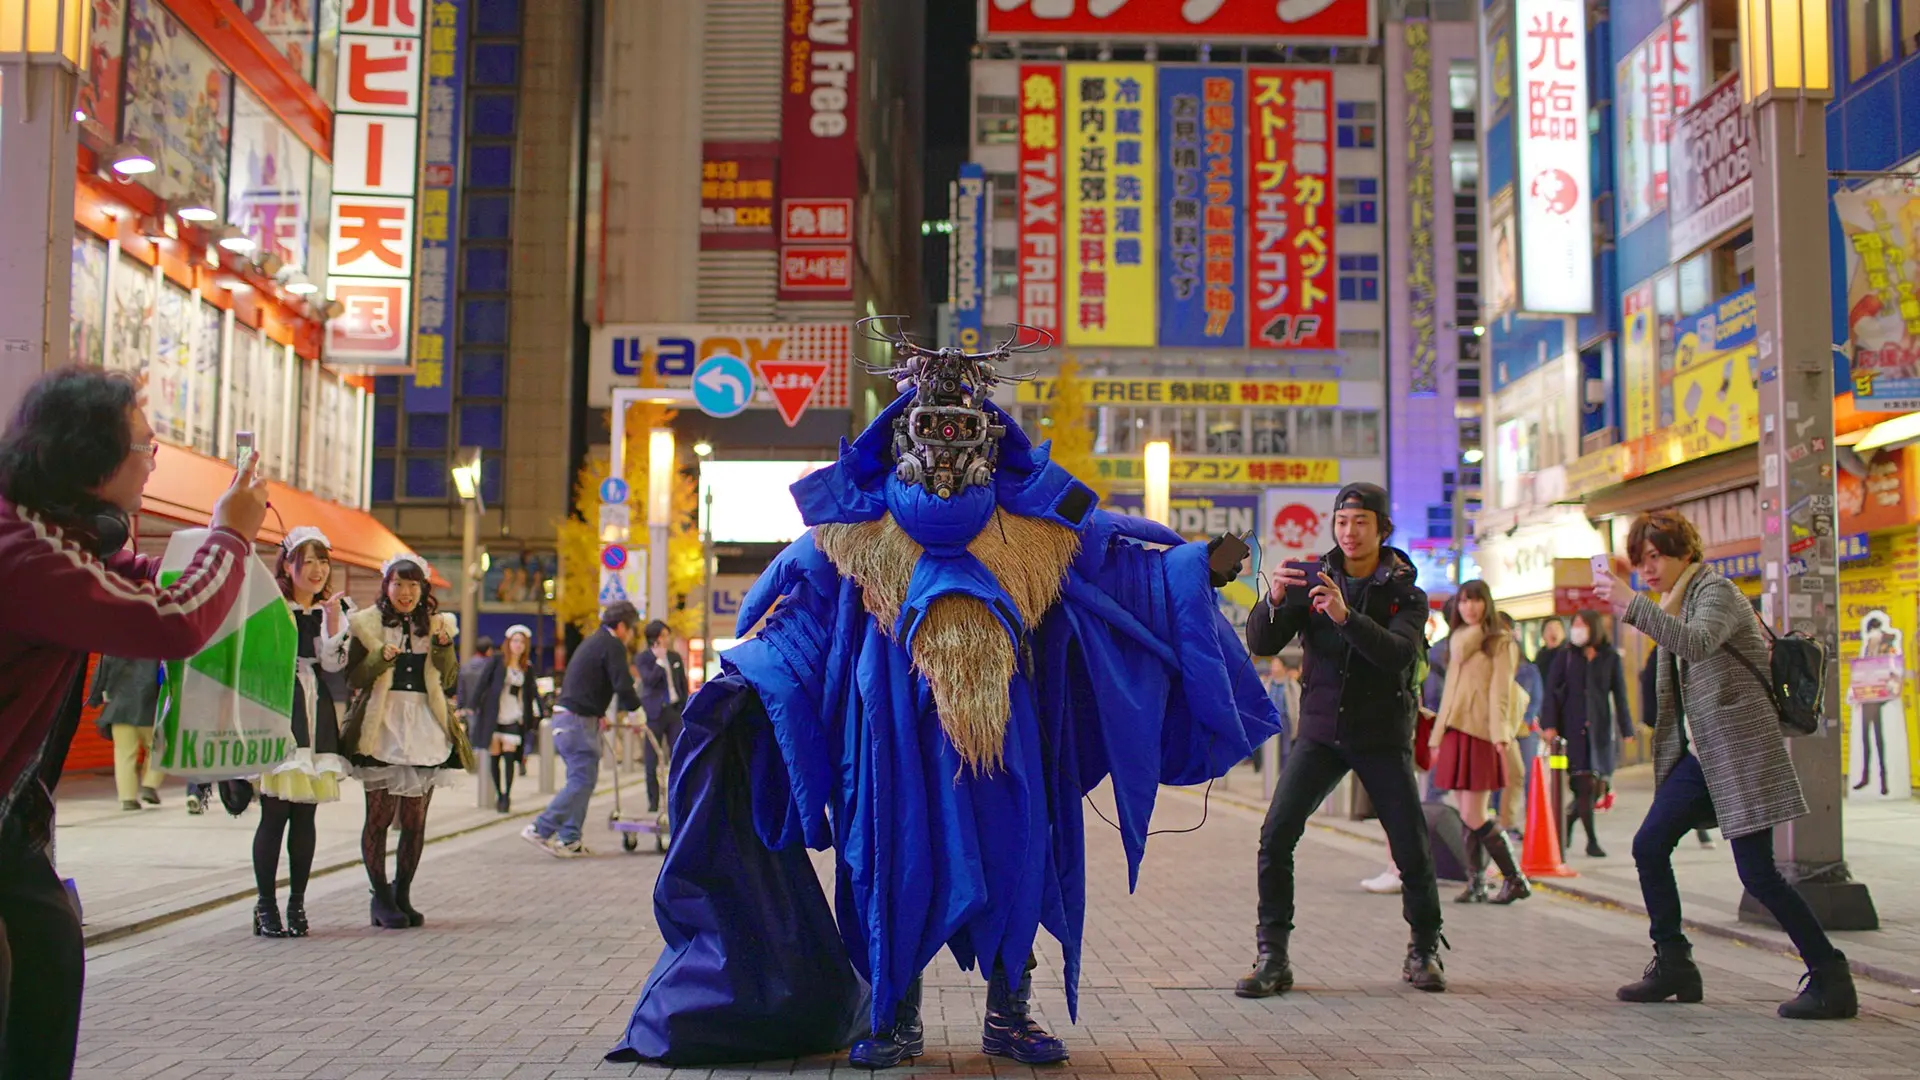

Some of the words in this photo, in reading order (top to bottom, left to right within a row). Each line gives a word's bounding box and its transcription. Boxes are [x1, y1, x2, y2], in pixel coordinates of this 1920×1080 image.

[790, 41, 811, 94] Store
[809, 51, 854, 138] Free
[1527, 11, 1577, 141] 光臨
[1022, 73, 1056, 149] 免税
[1023, 153, 1056, 225] TAX
[959, 178, 984, 311] Panasonic
[1023, 232, 1056, 331] FREE
[1260, 314, 1320, 344] 4F
[771, 373, 815, 388] 止まれ
[1031, 381, 1061, 401] TA
[1092, 381, 1162, 401] FREE
[1169, 380, 1230, 402] 免税店
[180, 729, 287, 769] KOTOBUK
